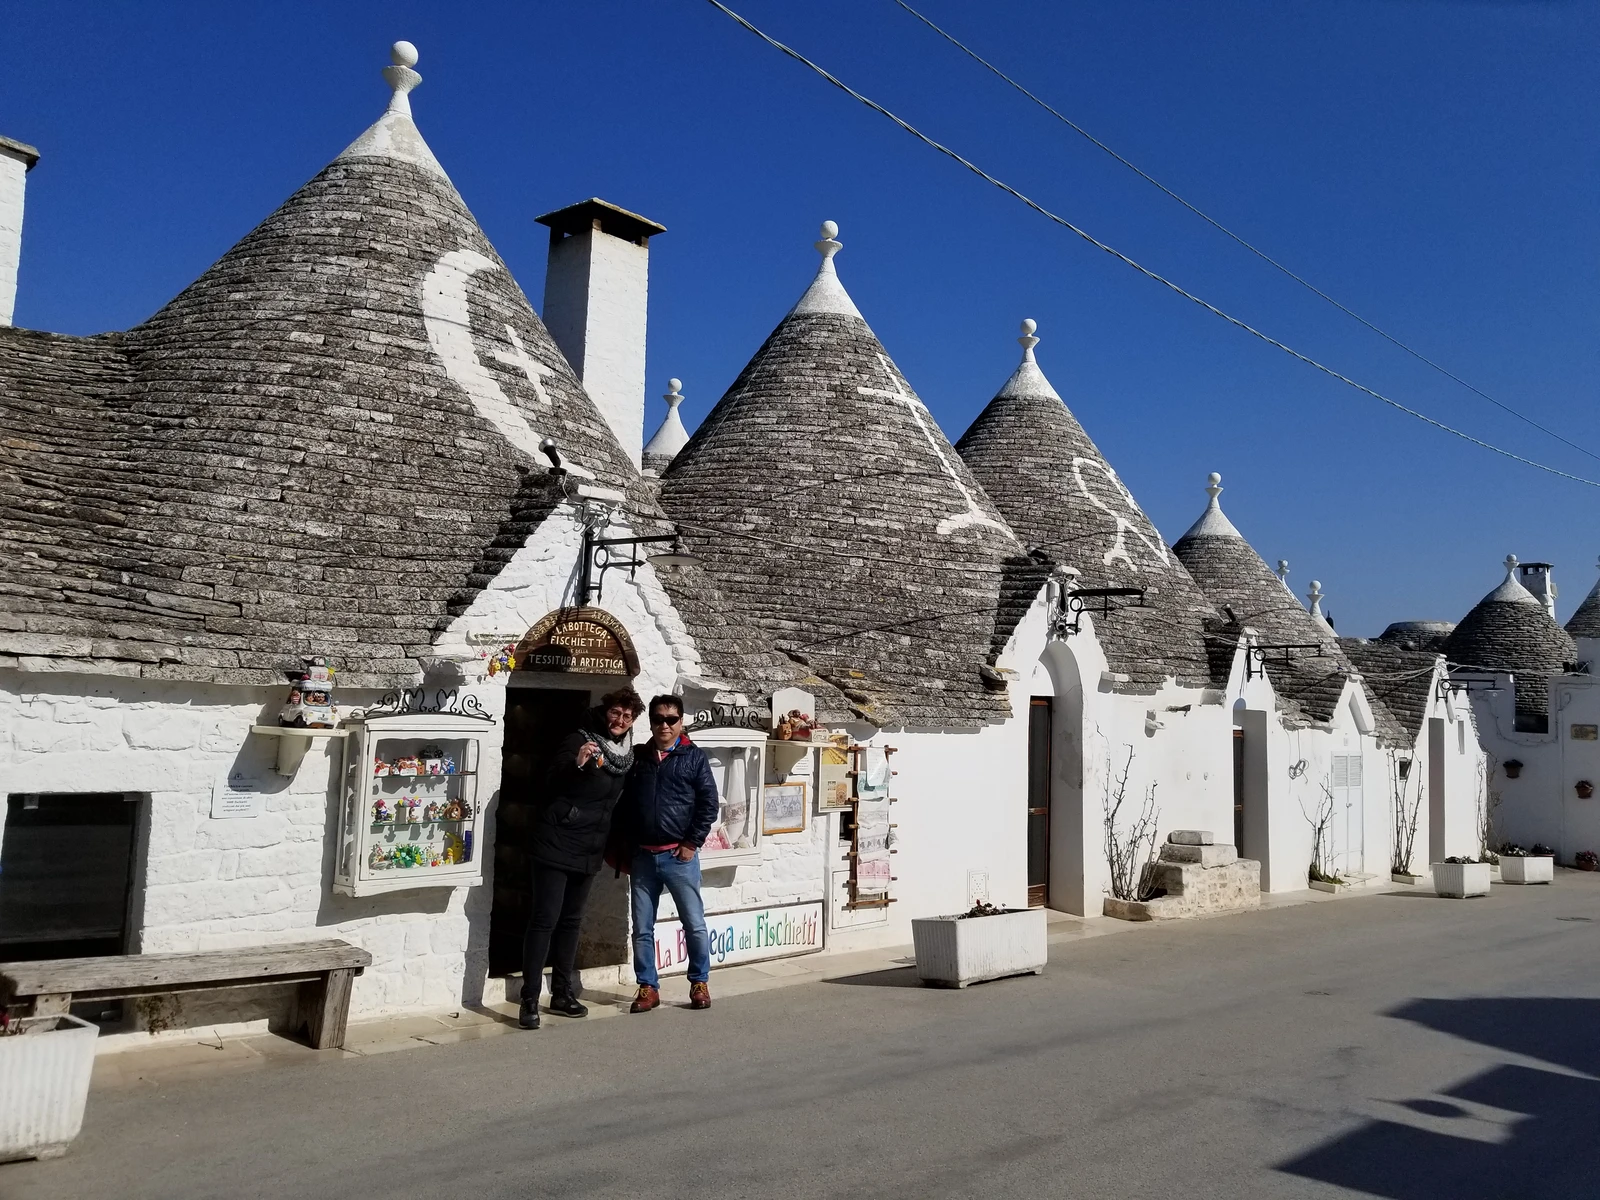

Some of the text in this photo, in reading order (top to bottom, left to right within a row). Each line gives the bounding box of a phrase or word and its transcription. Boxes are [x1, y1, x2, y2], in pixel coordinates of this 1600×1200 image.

[550, 635, 607, 648] FISCHIETTI
[528, 653, 624, 669] TESSITURA ARTISTICA
[655, 910, 818, 970] La Bega dei Fischietti
